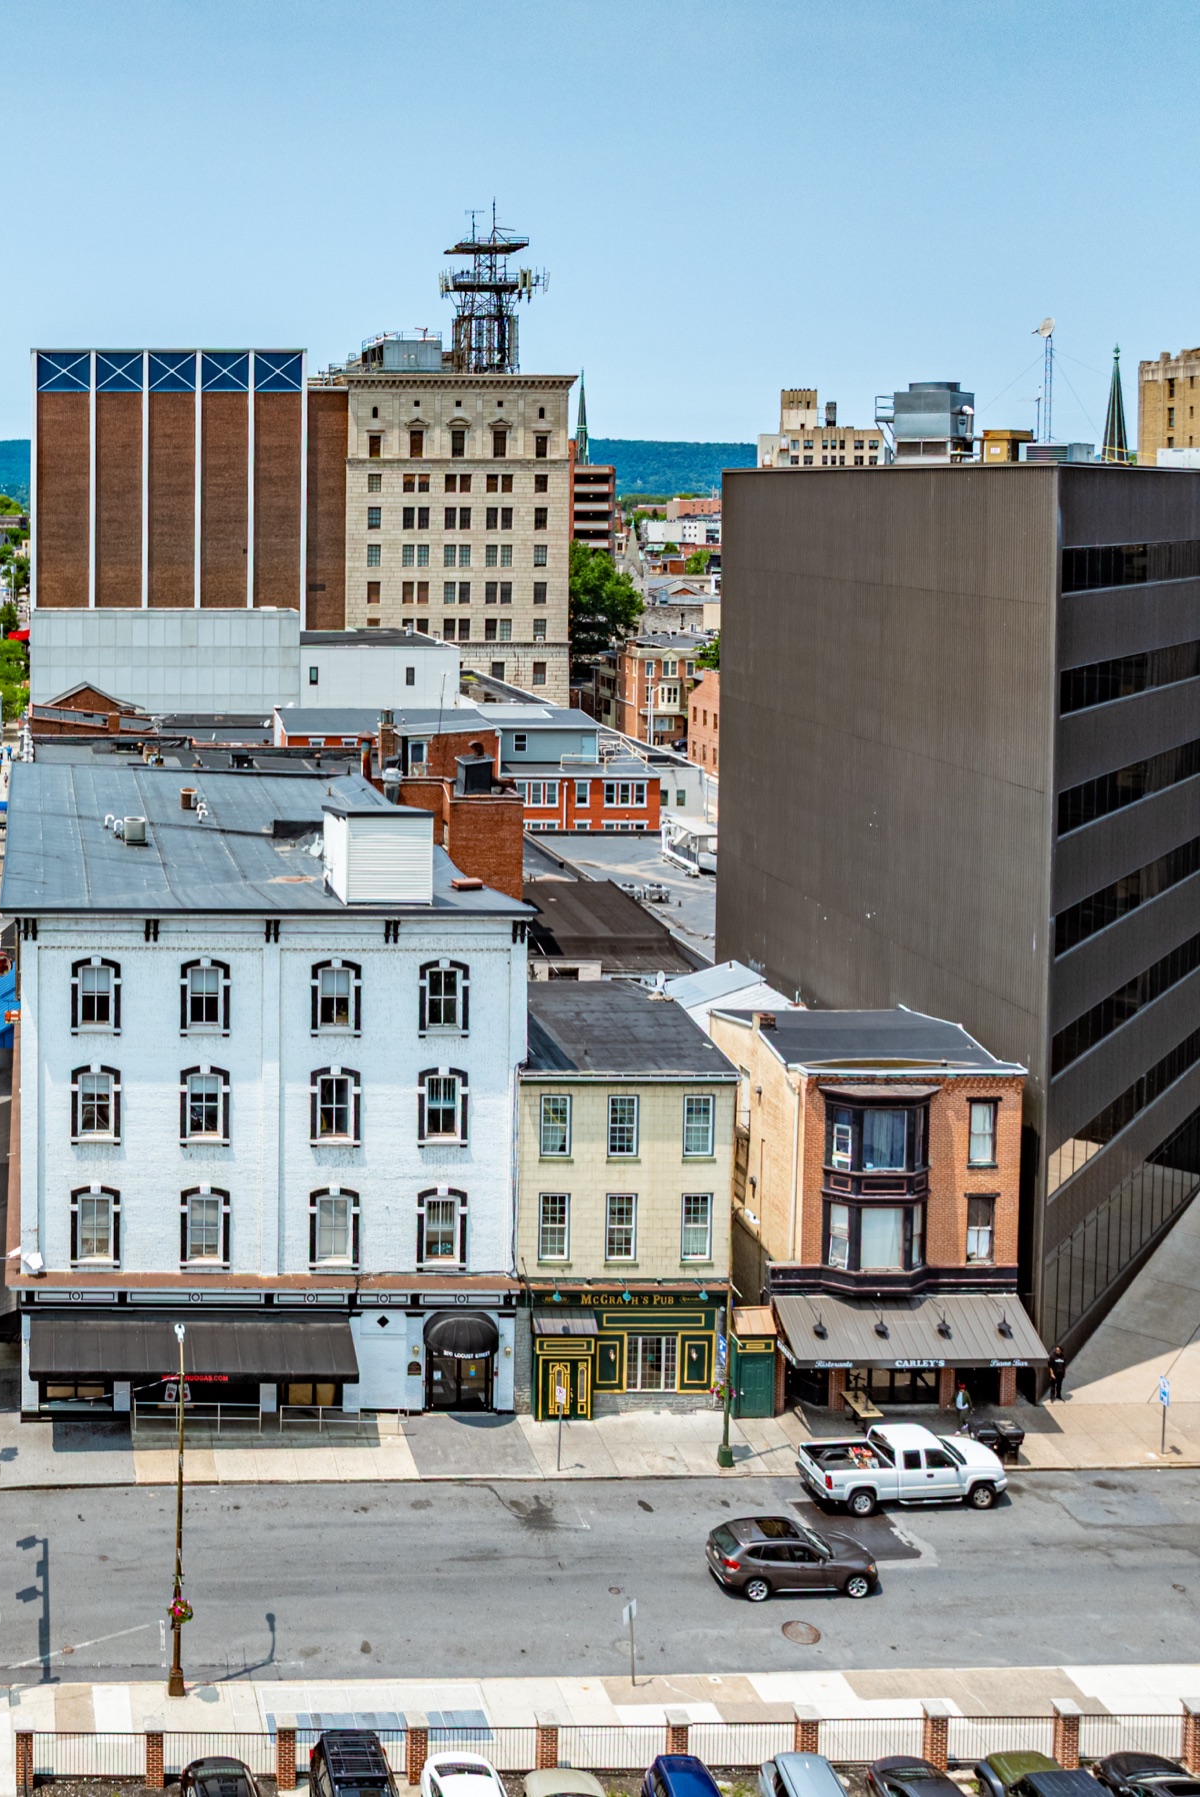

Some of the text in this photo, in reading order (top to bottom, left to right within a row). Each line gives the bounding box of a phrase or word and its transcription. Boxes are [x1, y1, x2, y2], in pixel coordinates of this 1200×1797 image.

[475, 1350, 490, 1358] STREET
[814, 1359, 1029, 1368] Ristorante CARLEY'S Piano Bar
